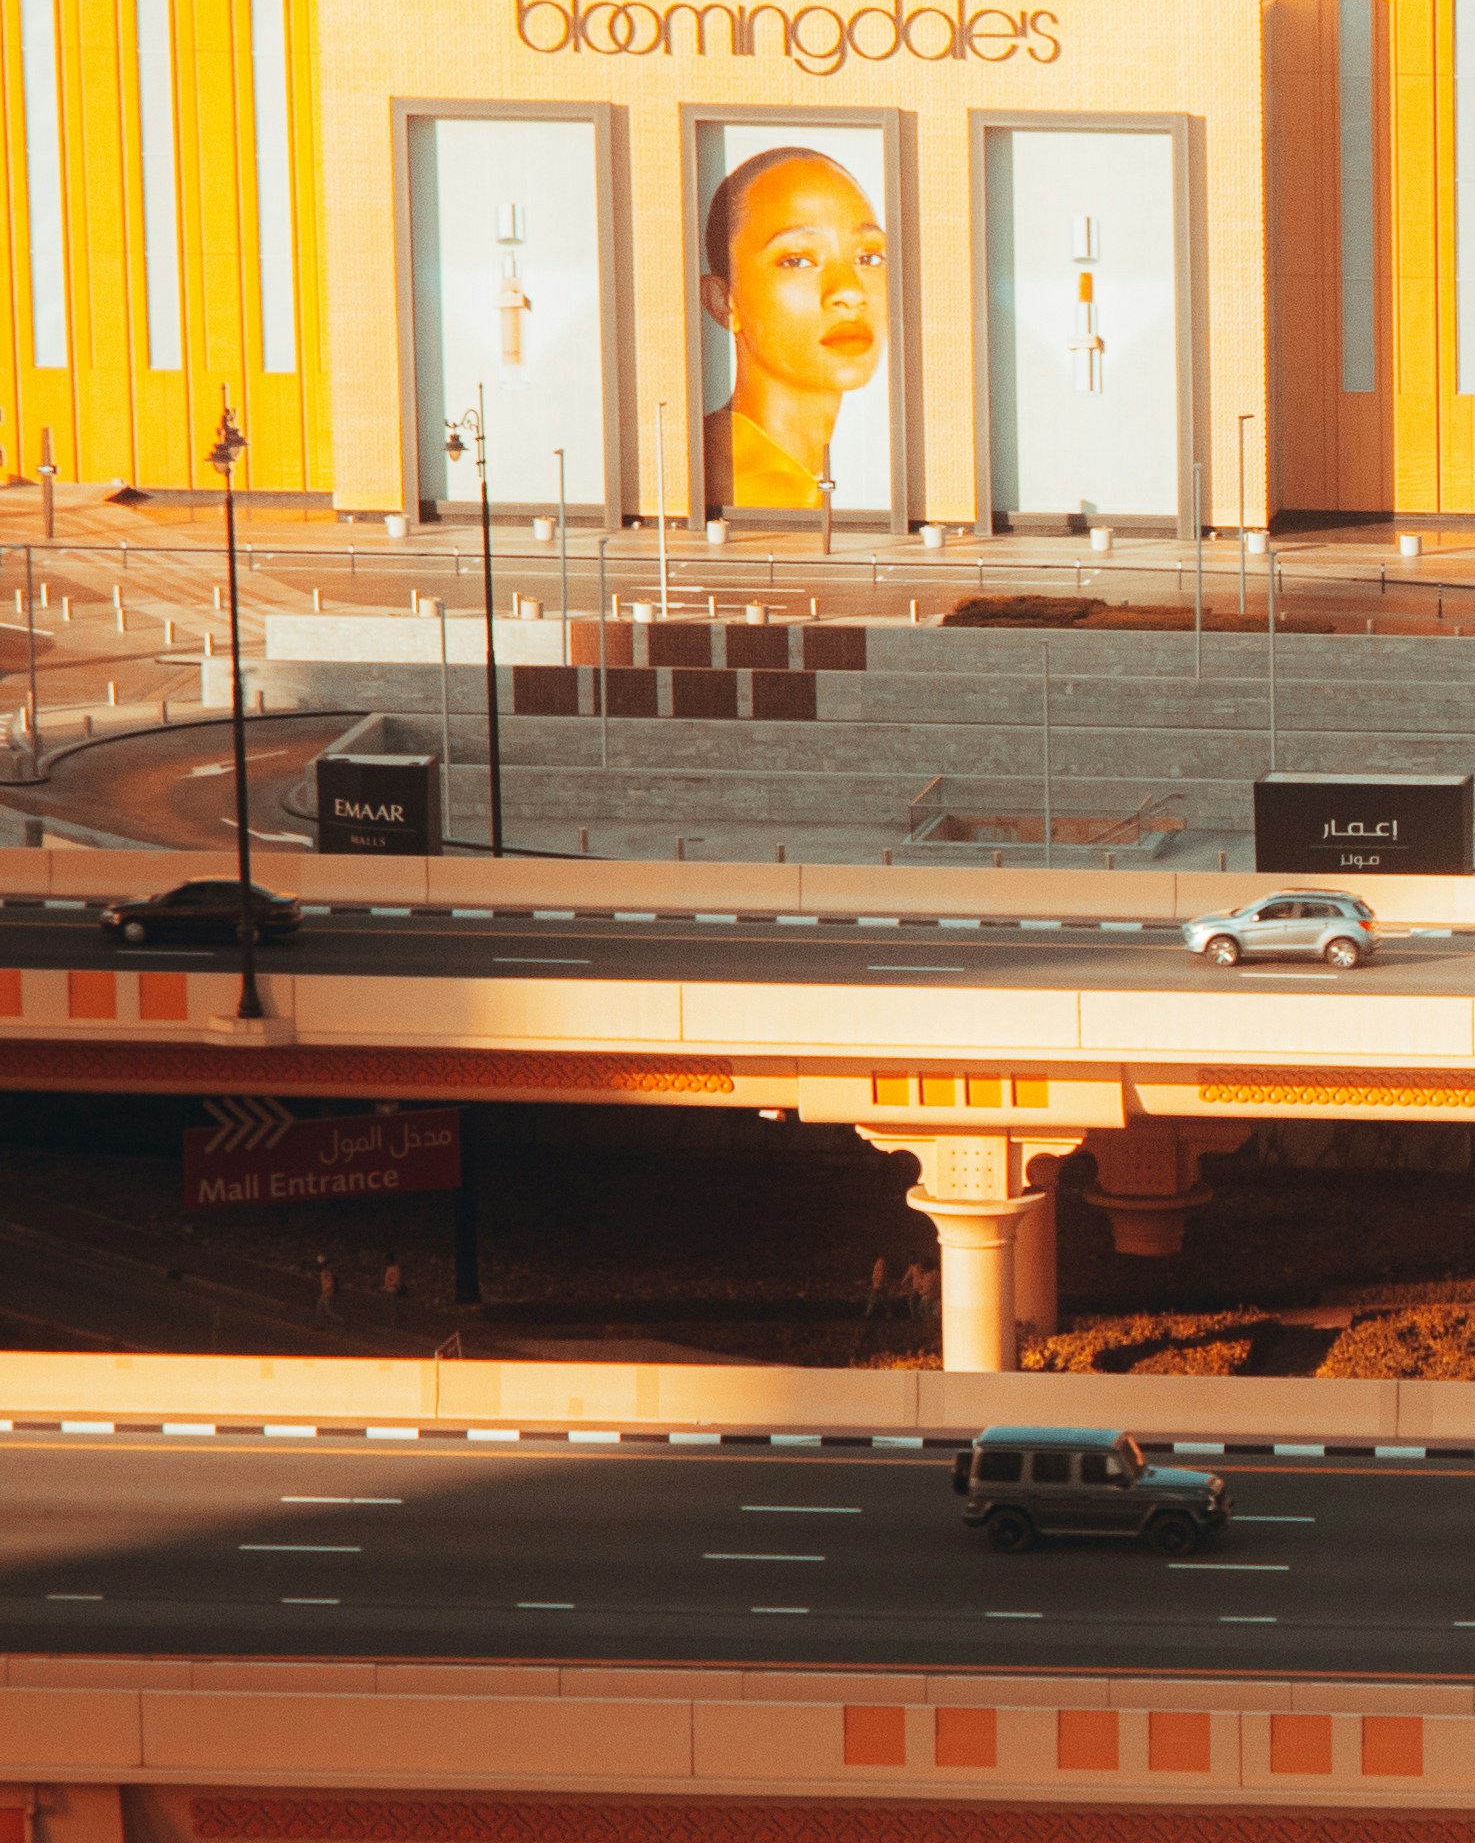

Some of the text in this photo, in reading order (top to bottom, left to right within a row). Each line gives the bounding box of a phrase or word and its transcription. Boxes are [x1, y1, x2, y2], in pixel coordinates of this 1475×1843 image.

[334, 798, 406, 824] EMAAR
[1322, 819, 1398, 841] إعمار
[1340, 853, 1381, 870] مولز
[318, 1122, 453, 1166] مدخل المول
[198, 1168, 400, 1204] Mall Entrance
